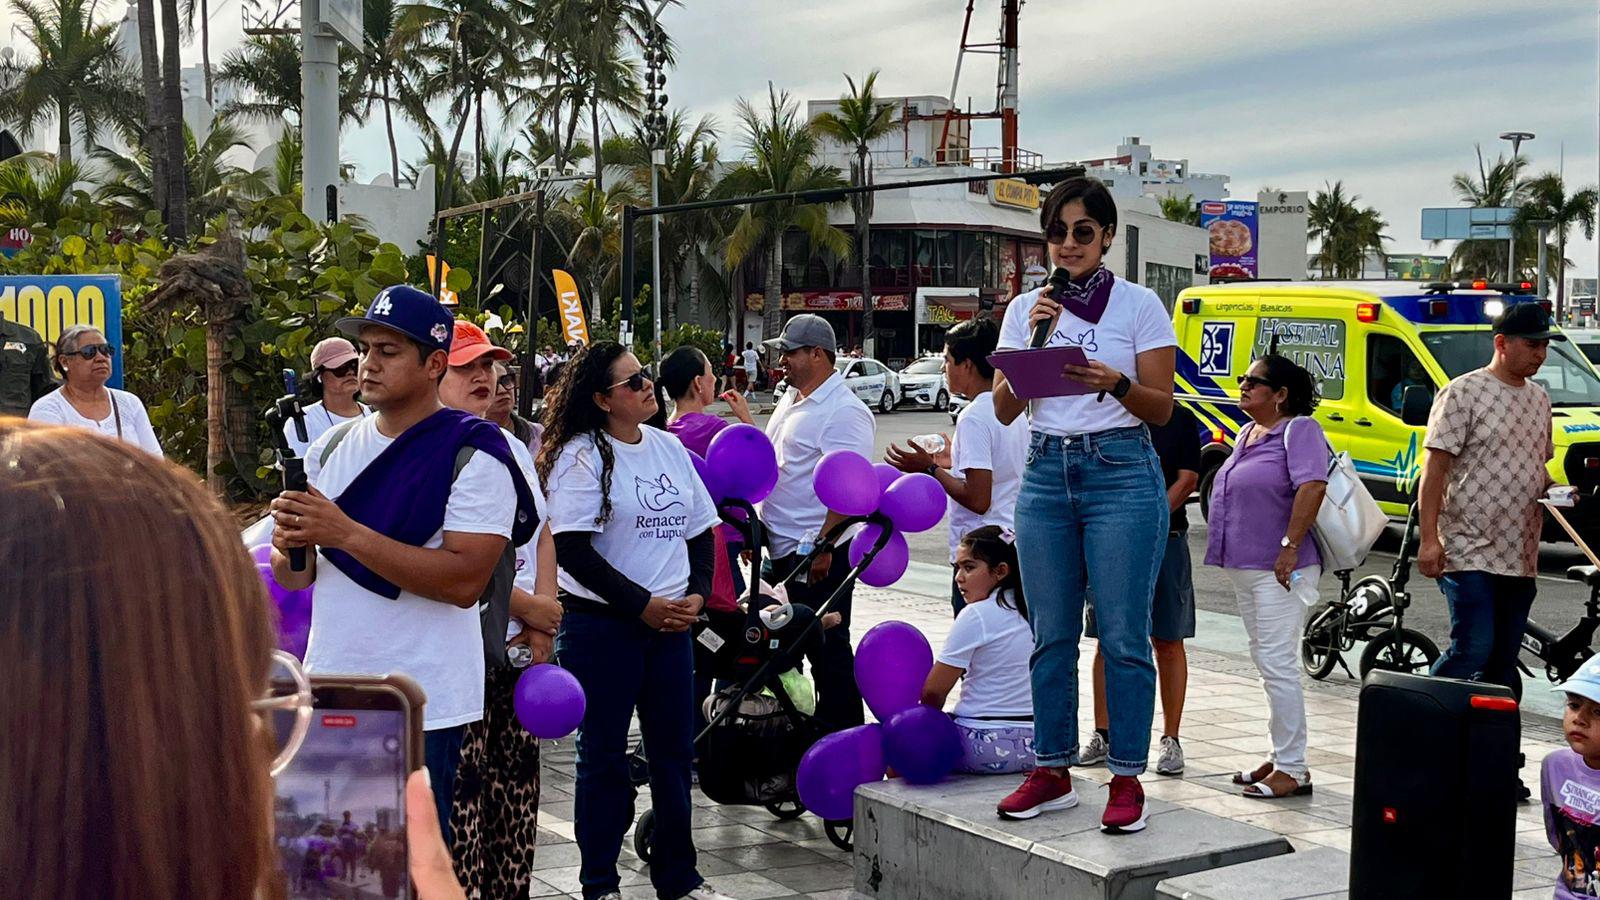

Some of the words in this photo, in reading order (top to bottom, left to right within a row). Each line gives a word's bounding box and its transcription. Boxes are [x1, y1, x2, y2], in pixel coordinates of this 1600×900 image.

[1260, 205, 1304, 214] EMPORIO
[1257, 317, 1340, 348] HOSPITAL
[635, 515, 687, 529] Renacer
[638, 530, 654, 539] con
